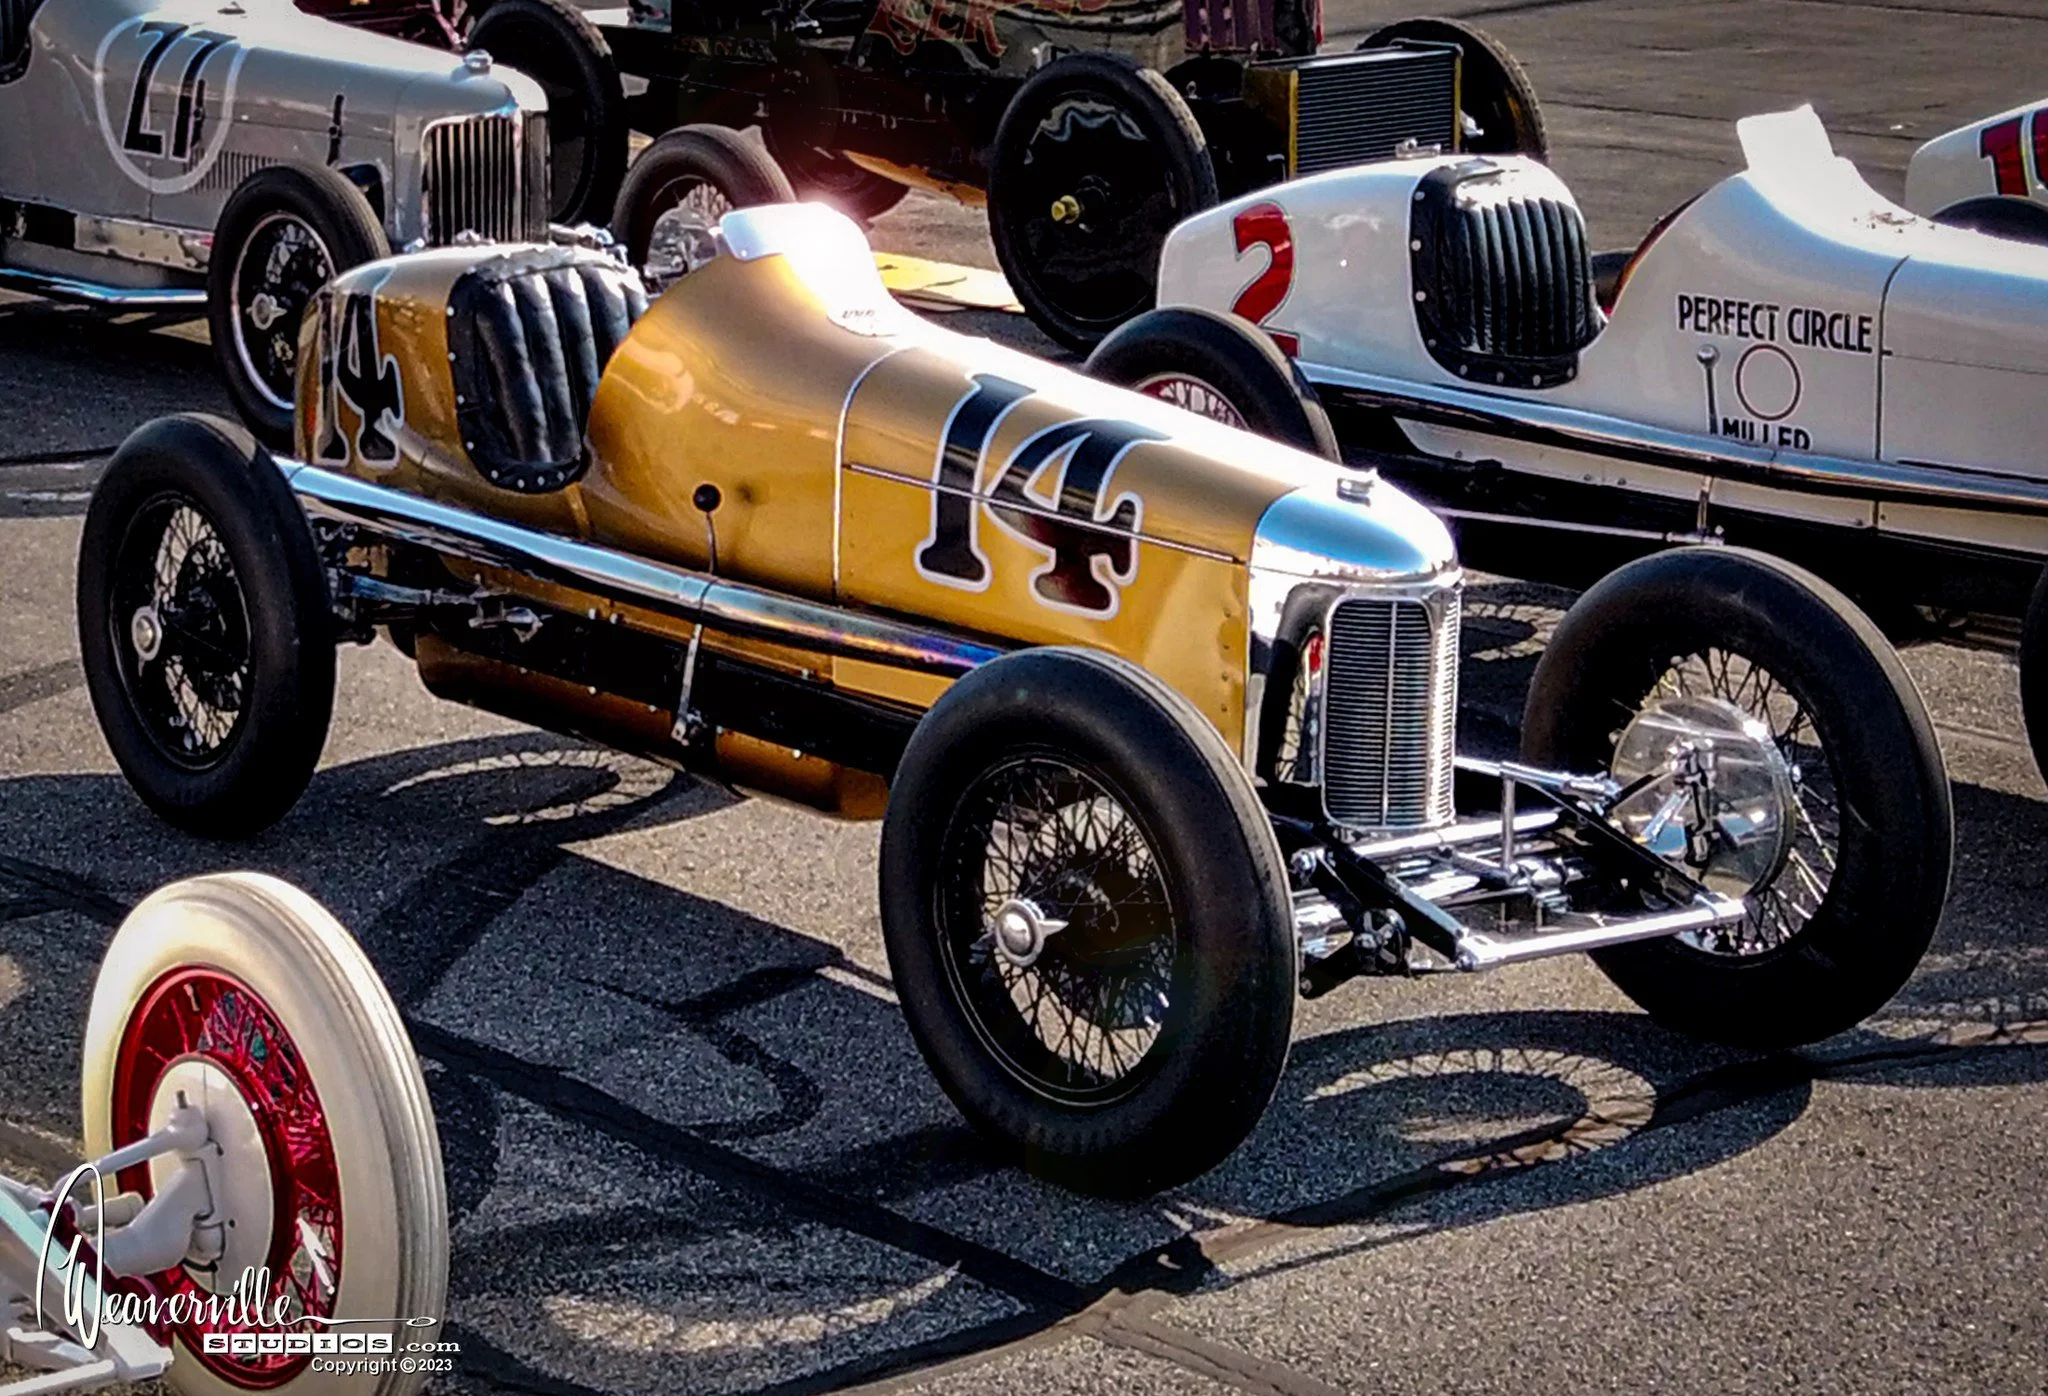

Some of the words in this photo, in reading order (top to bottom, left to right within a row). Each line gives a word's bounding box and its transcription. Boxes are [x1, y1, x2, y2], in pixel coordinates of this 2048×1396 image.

[313, 264, 405, 469] 14
[1229, 199, 1301, 359] 2
[1677, 293, 1780, 342] PERFECT
[1786, 306, 1873, 354] CIRCLE
[914, 372, 1173, 621] 14
